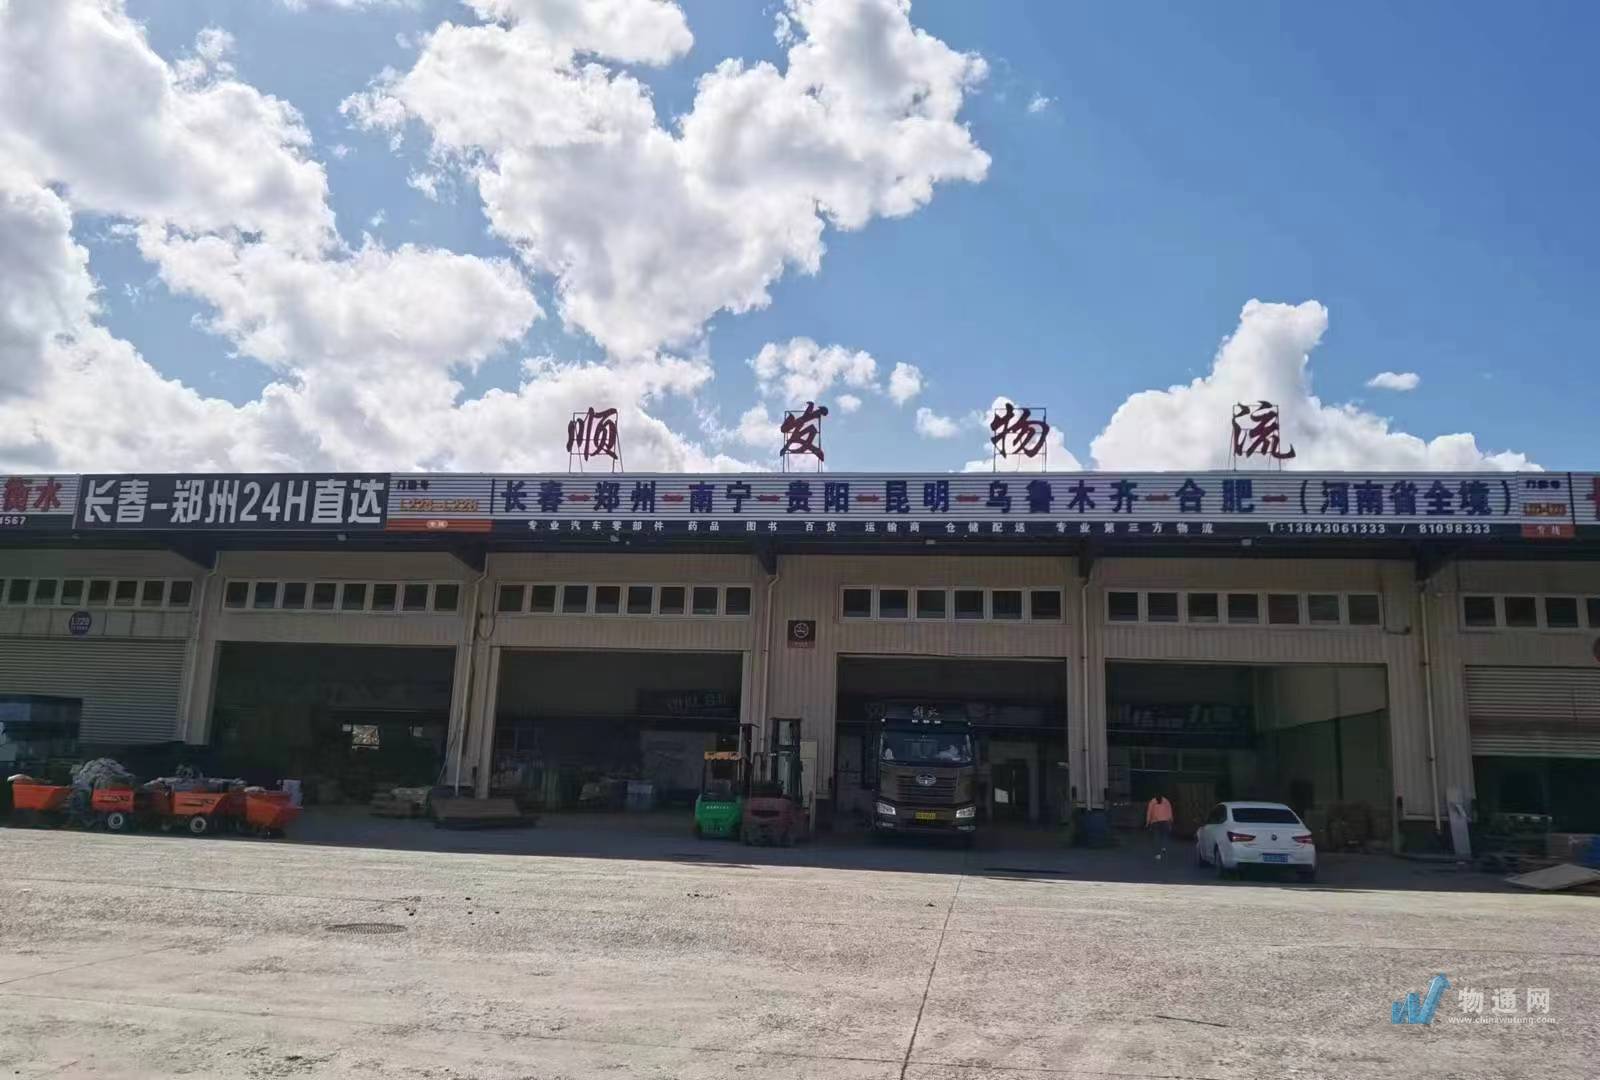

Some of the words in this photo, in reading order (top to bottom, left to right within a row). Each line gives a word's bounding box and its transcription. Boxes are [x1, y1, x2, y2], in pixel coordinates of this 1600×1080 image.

[566, 401, 1298, 461] 顺发物流
[84, 479, 385, 524] 长春-郑州24H直达
[1056, 522, 1214, 534] 专业第三方物流
